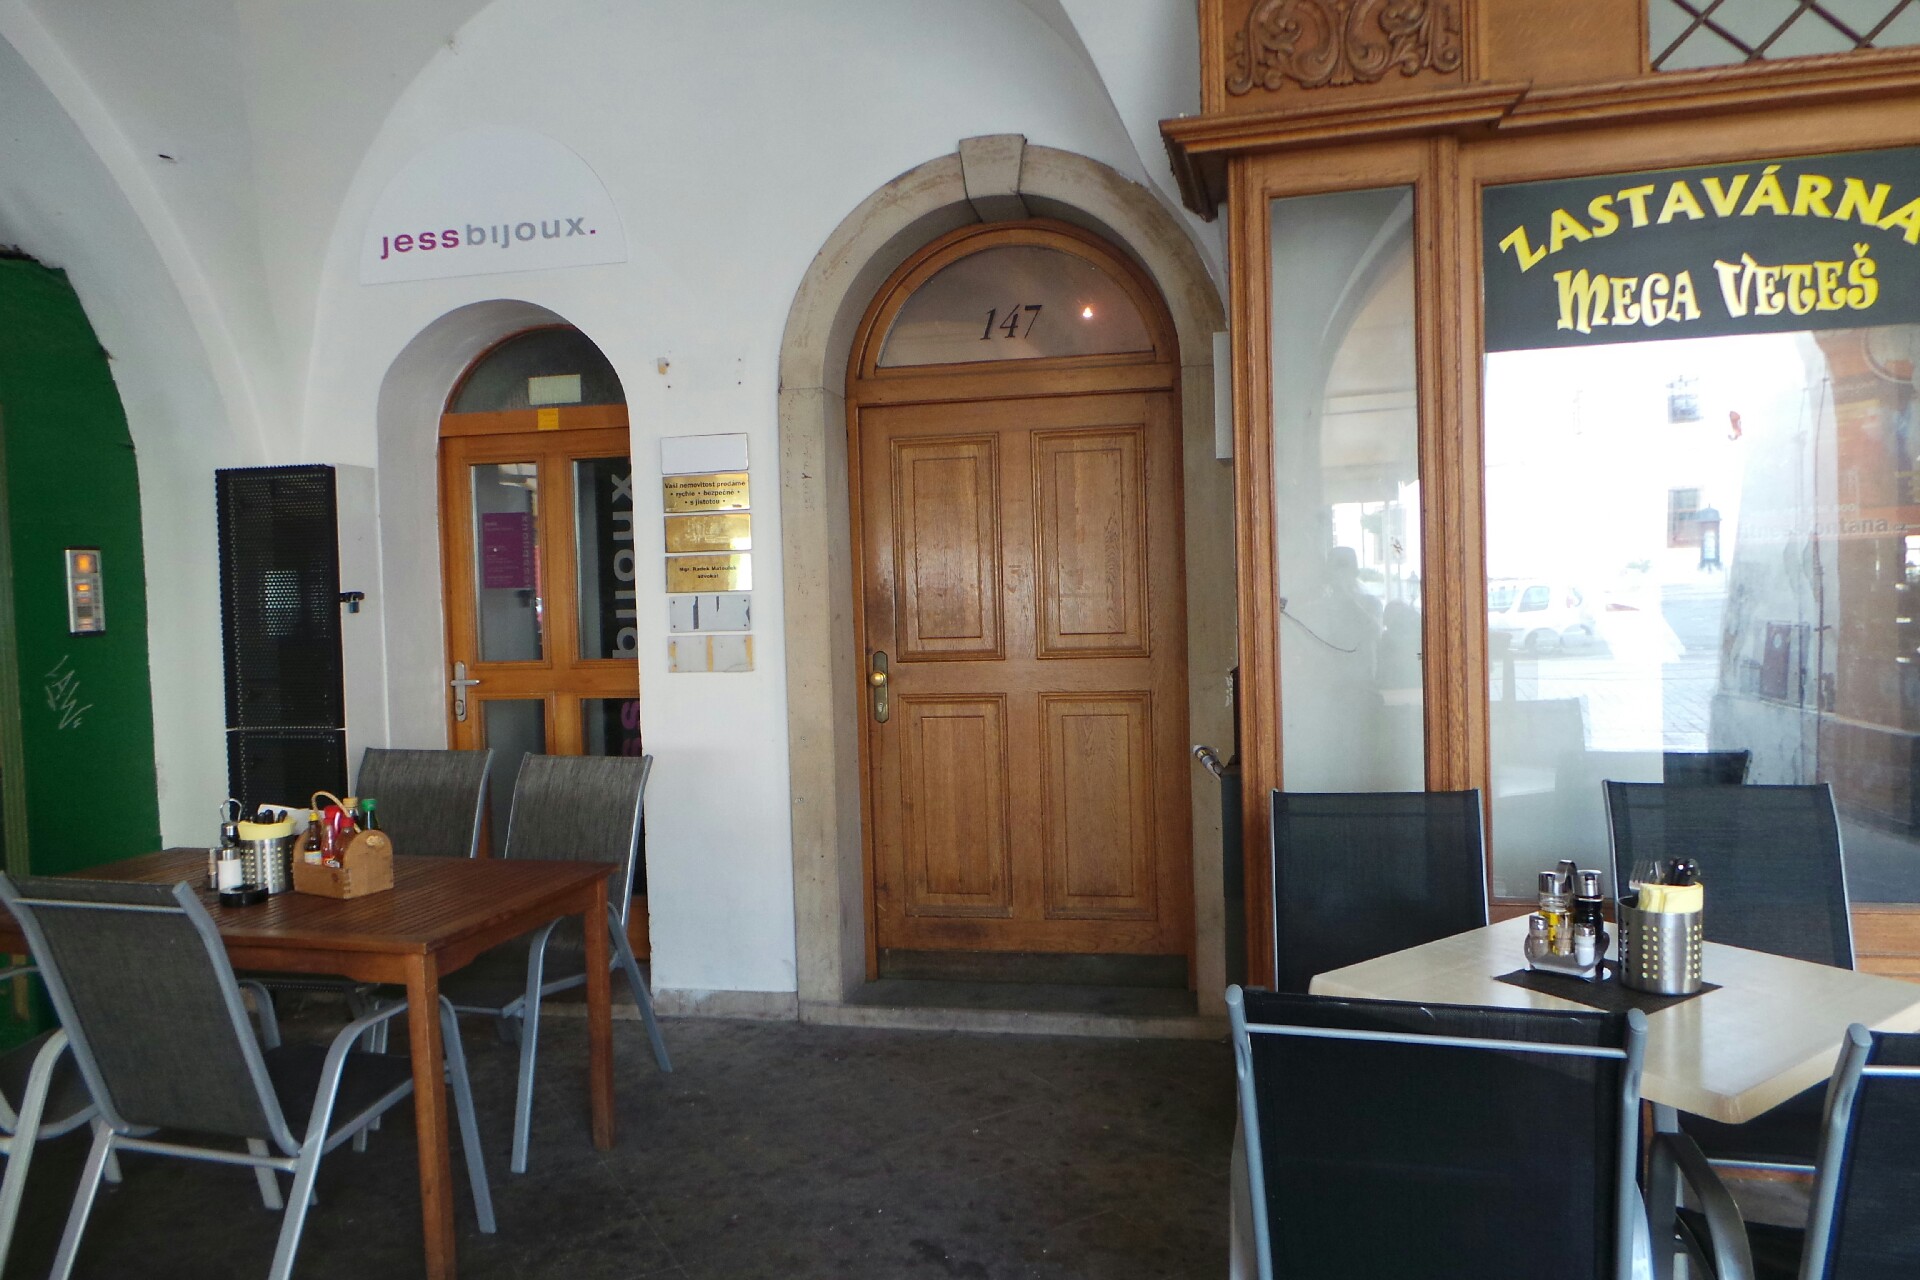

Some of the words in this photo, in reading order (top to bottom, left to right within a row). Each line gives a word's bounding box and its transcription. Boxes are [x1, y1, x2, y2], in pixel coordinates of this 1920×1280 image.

[1498, 165, 1920, 274] ZASTAVÁRNA
[980, 303, 1043, 341] 147
[1553, 269, 1701, 335] MEGA
[1713, 242, 1879, 319] VETEŠ
